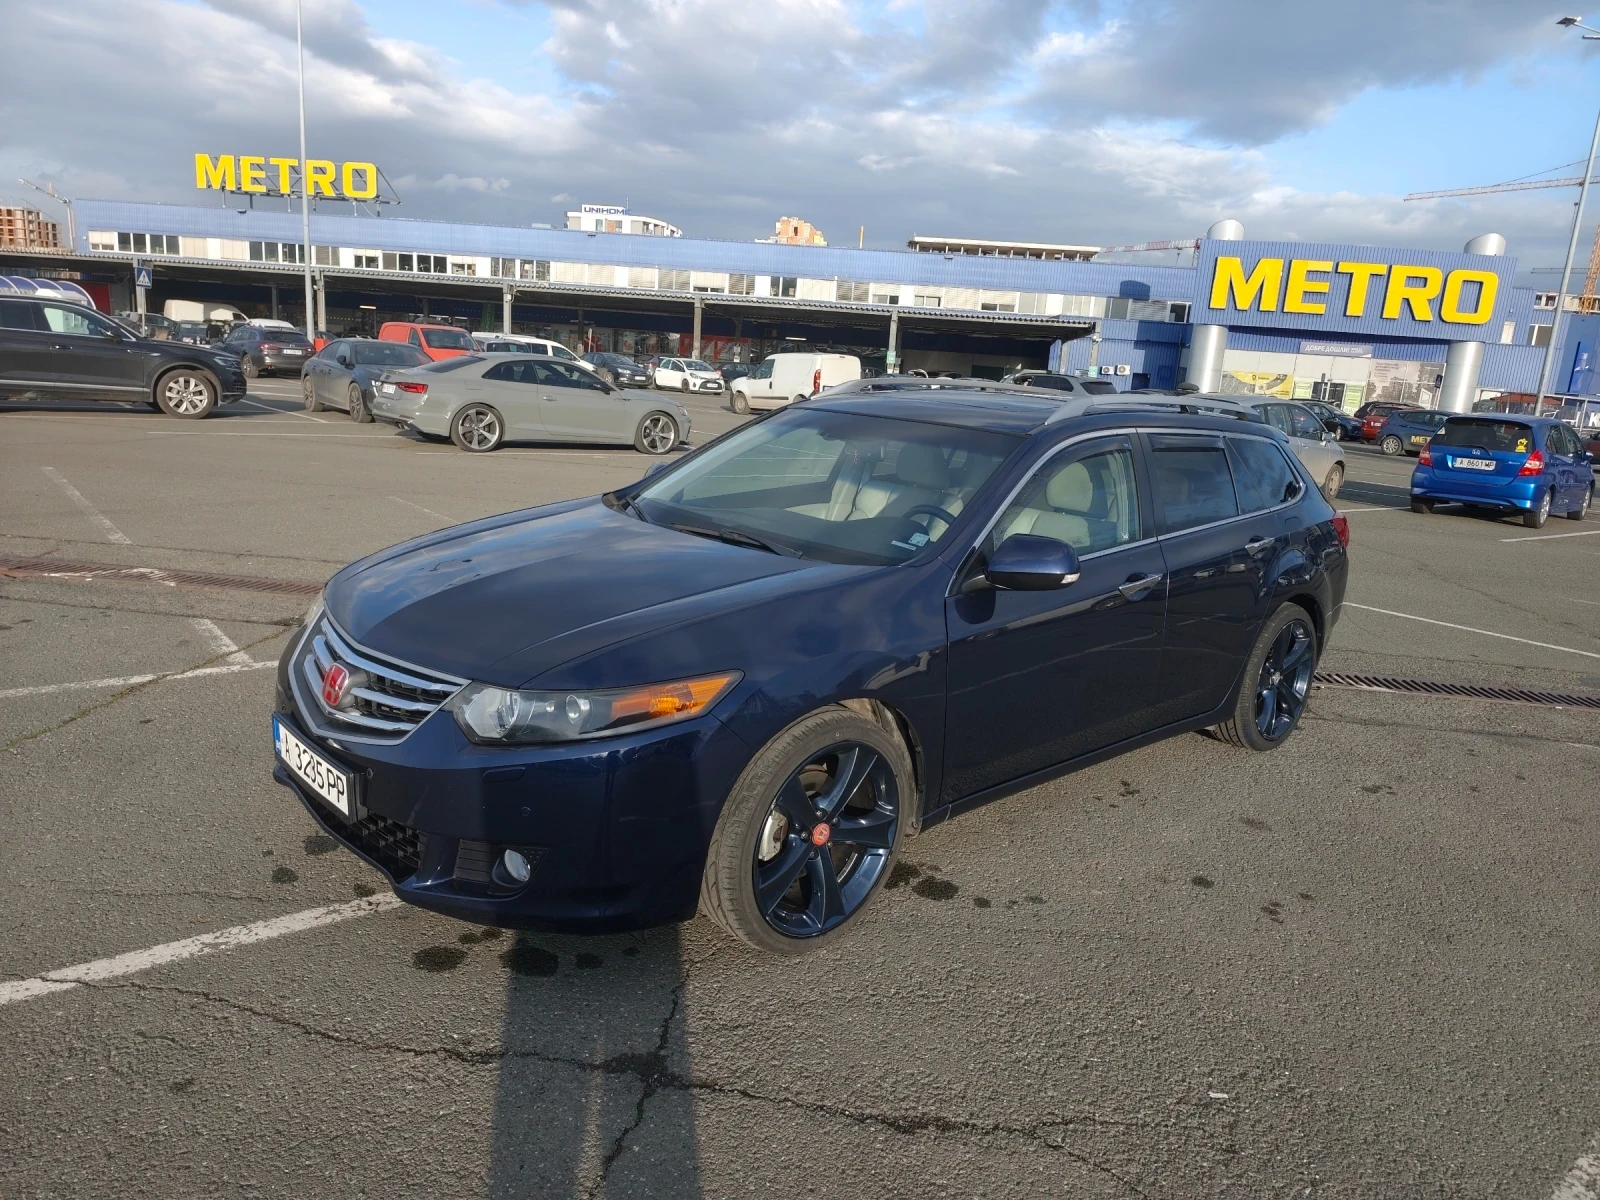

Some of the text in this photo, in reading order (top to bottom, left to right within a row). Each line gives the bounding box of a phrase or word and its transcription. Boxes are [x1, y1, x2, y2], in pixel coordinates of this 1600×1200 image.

[194, 153, 378, 199] METRO
[1209, 256, 1499, 325] METRO
[1410, 435, 1433, 443] MET
[1466, 460, 1483, 468] 8601
[284, 733, 292, 762] A
[295, 742, 325, 790] 3235
[326, 767, 345, 803] PP
